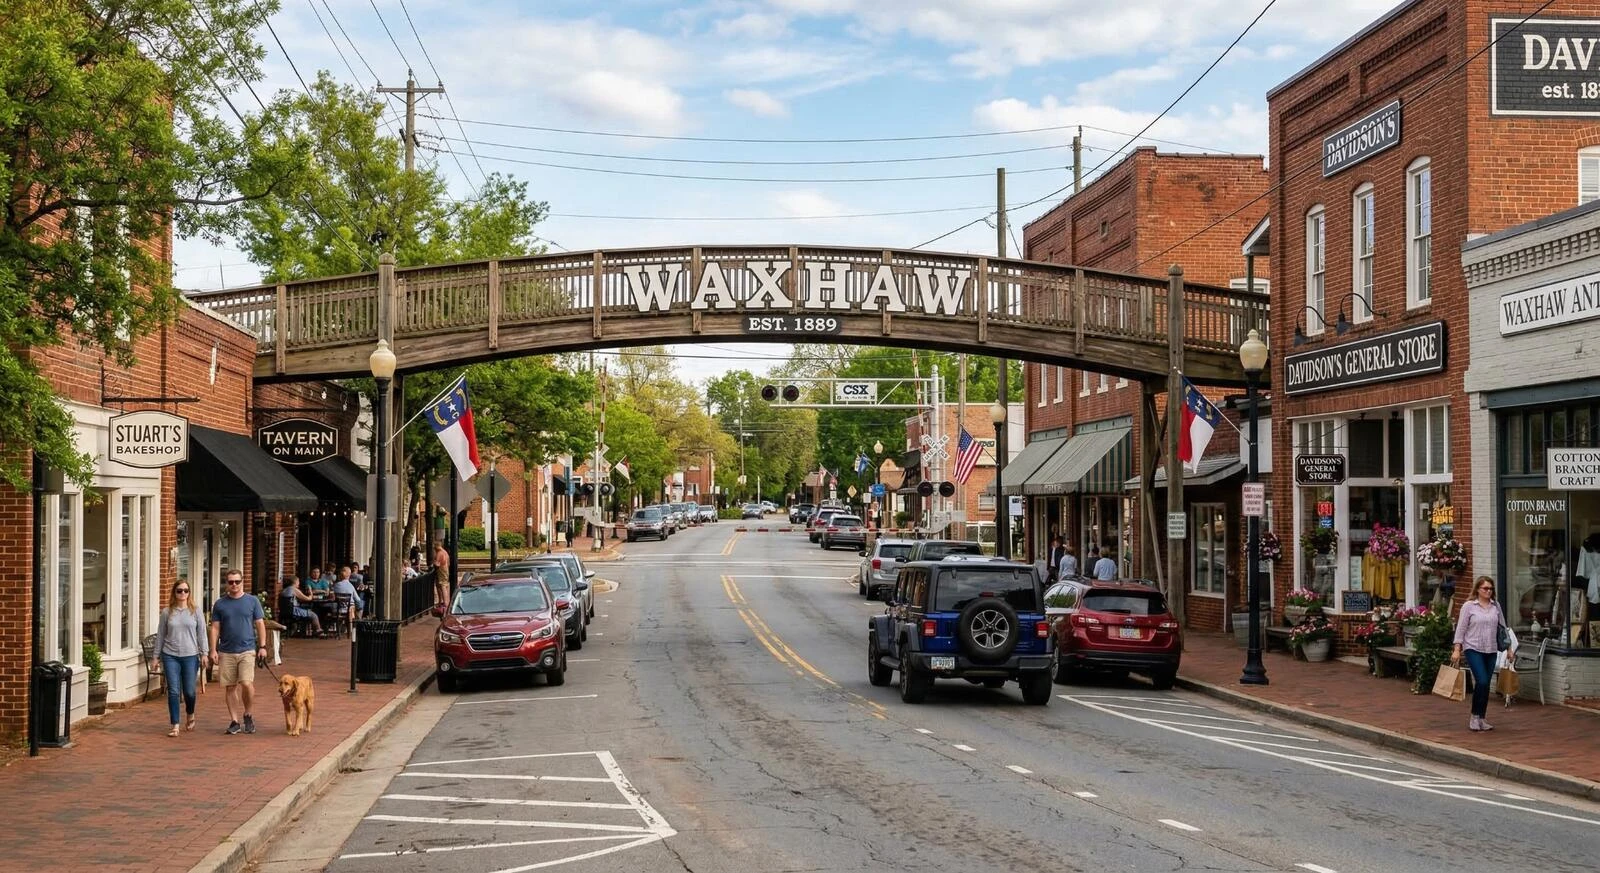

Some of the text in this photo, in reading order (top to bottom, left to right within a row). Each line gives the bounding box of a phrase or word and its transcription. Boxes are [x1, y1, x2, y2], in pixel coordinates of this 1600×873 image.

[1522, 34, 1600, 70] DAV
[1542, 82, 1600, 99] est. 18
[1327, 110, 1396, 168] DAVIDSON'S
[623, 261, 972, 315] WAXHAW
[1503, 288, 1566, 326] WAXHAW
[748, 317, 837, 331] EST. 1889
[1288, 333, 1438, 386] DAVIDSON'S GENERAL STORE
[842, 384, 868, 394] CSX
[116, 425, 181, 442] STUART'S
[263, 432, 334, 445] TAVERN
[116, 446, 180, 454] BAKESHOP
[273, 448, 324, 456] ON MAIN
[1554, 453, 1600, 462] COTTON
[1556, 464, 1600, 474] BRANCH
[1560, 476, 1596, 486] CRAFT
[1506, 500, 1566, 512] COTTON BRANCH
[1524, 514, 1548, 526] CRAFT
